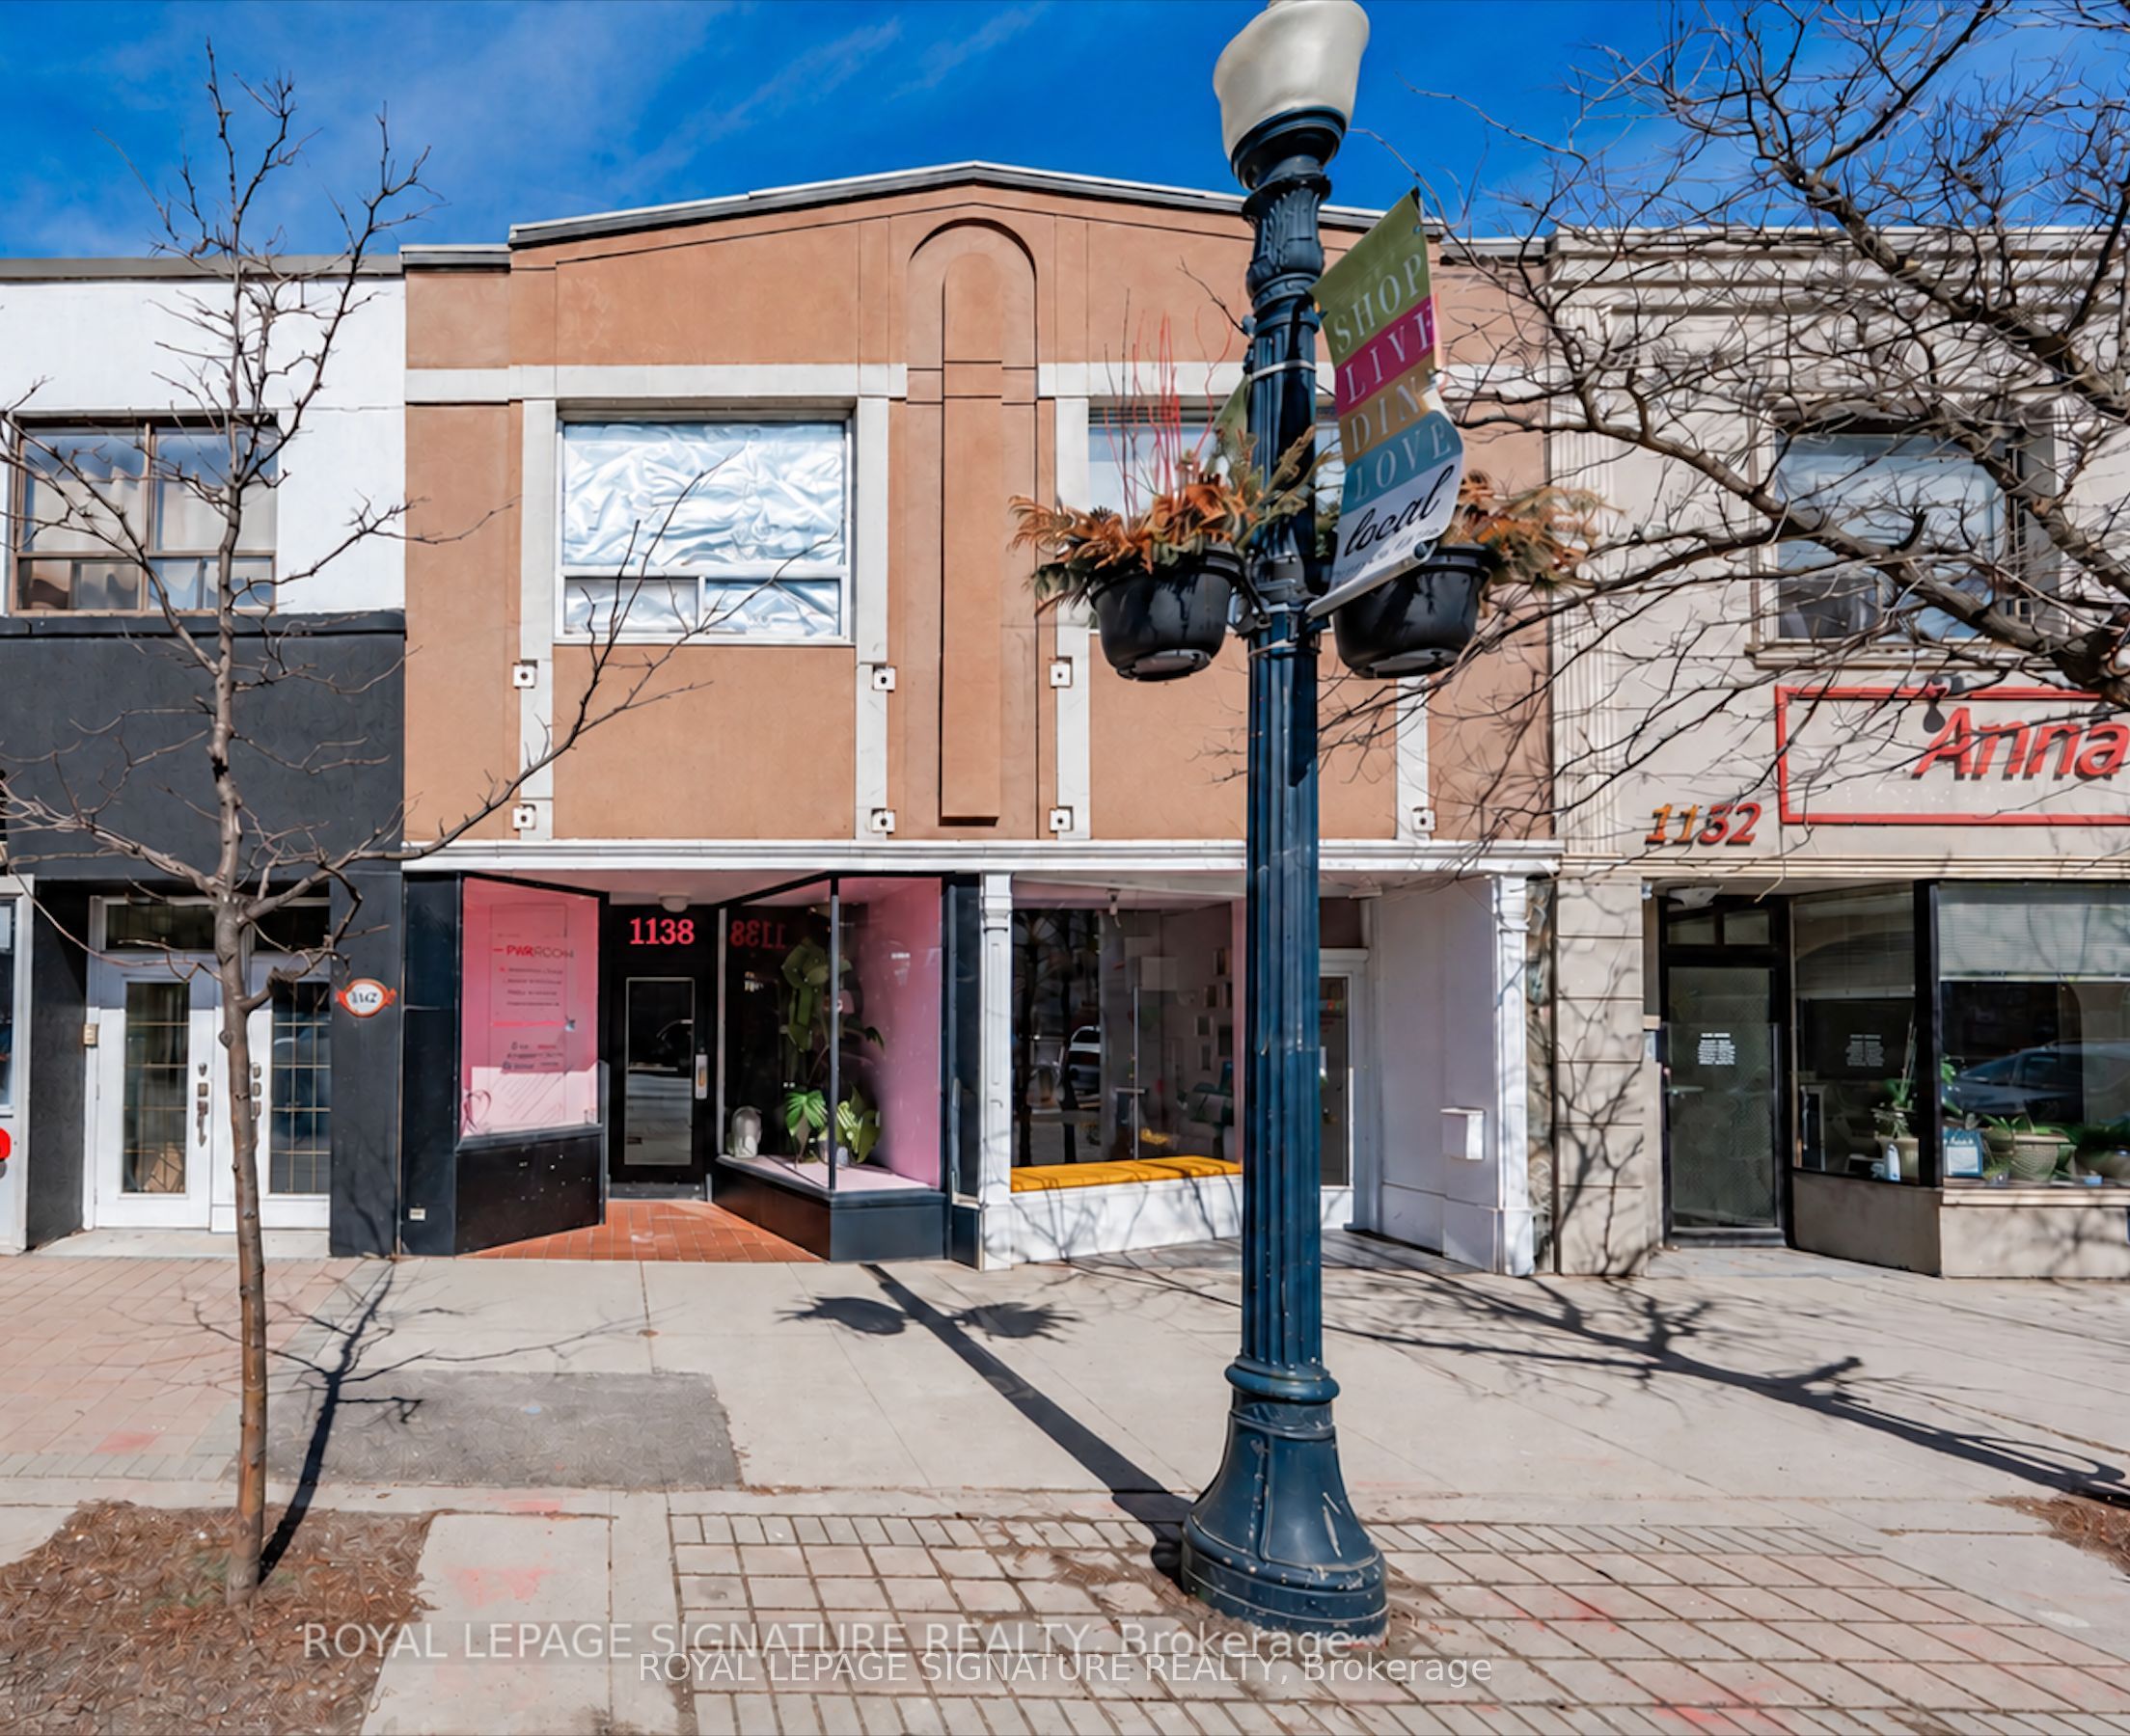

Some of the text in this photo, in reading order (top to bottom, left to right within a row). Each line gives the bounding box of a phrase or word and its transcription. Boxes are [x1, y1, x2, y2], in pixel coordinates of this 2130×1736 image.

[1333, 254, 1422, 354] SHOP
[1352, 375, 1421, 454] DIN
[1354, 420, 1453, 502] LOVE
[1344, 465, 1455, 557] local
[1911, 707, 2130, 780] Anna
[629, 917, 696, 946] 1138
